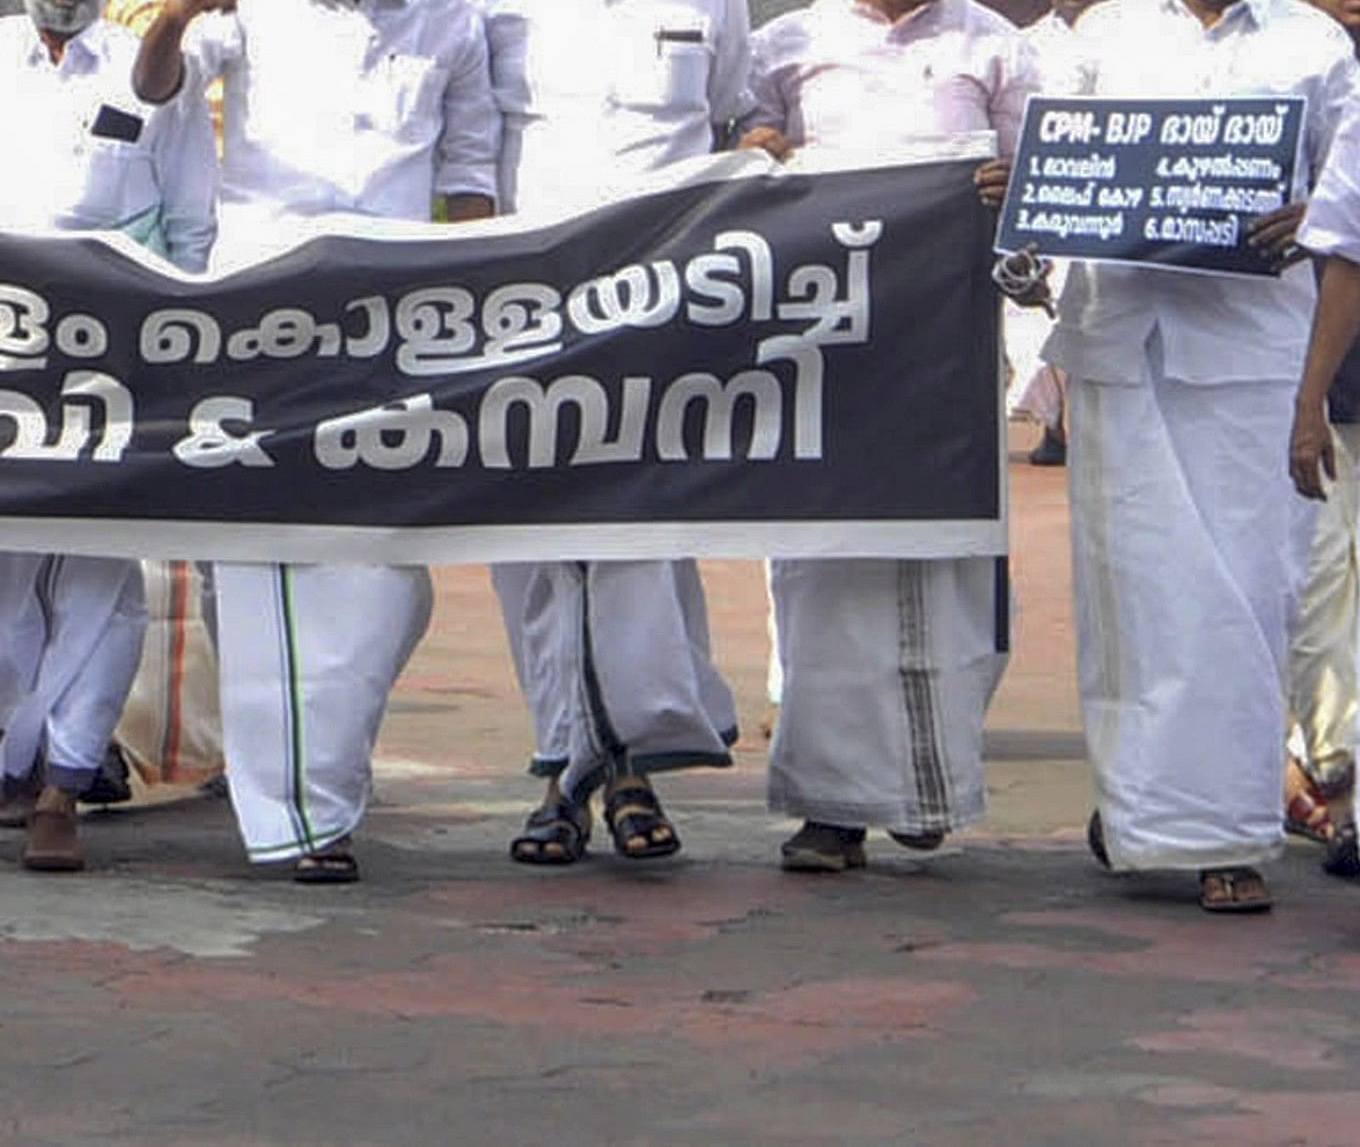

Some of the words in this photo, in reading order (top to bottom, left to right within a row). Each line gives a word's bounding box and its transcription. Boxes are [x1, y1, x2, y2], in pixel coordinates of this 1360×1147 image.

[1105, 112, 1153, 145] BJP
[1160, 104, 1226, 145] ഭായ്
[1224, 104, 1289, 146] ഭായ്
[140, 219, 883, 376] കൊള്ളയടിച്ച്
[171, 396, 276, 468] &
[314, 335, 825, 469] കമ്പനി
